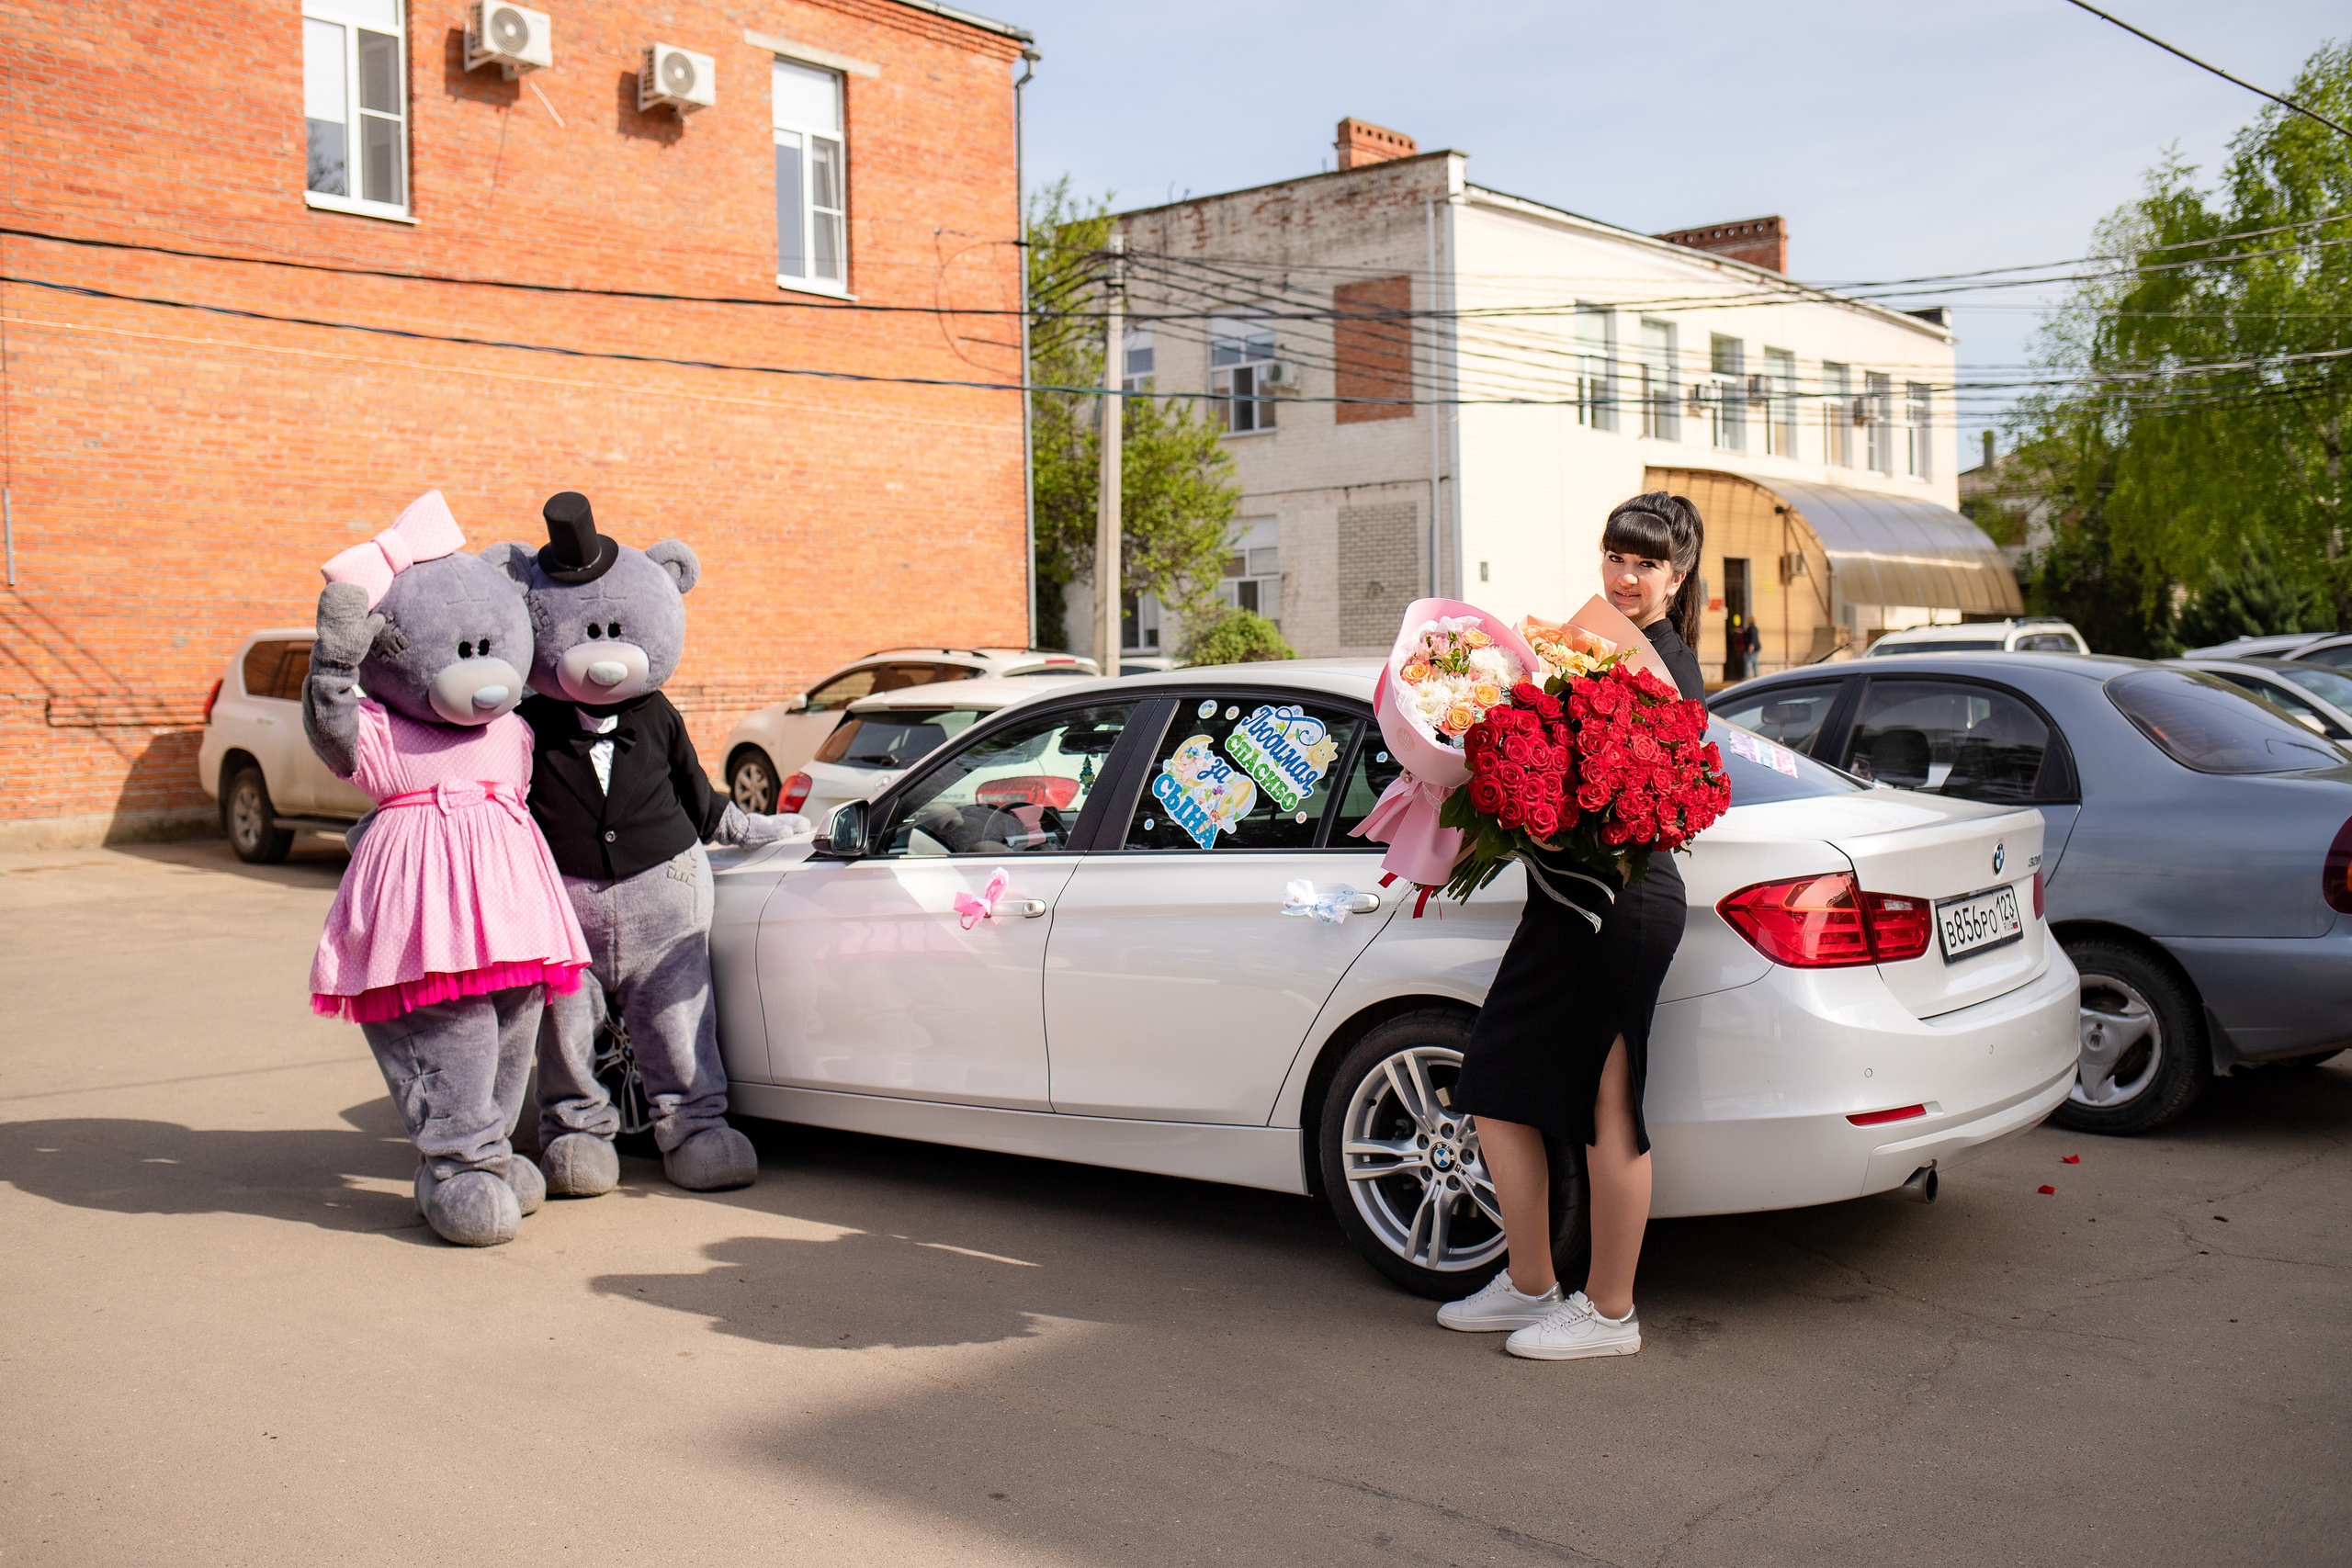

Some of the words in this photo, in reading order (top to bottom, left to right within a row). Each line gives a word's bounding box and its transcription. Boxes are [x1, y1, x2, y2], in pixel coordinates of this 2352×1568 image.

[1197, 758, 1231, 784] за
[1227, 735, 1297, 809] СПАСИБО
[1154, 773, 1217, 850] СЫНА
